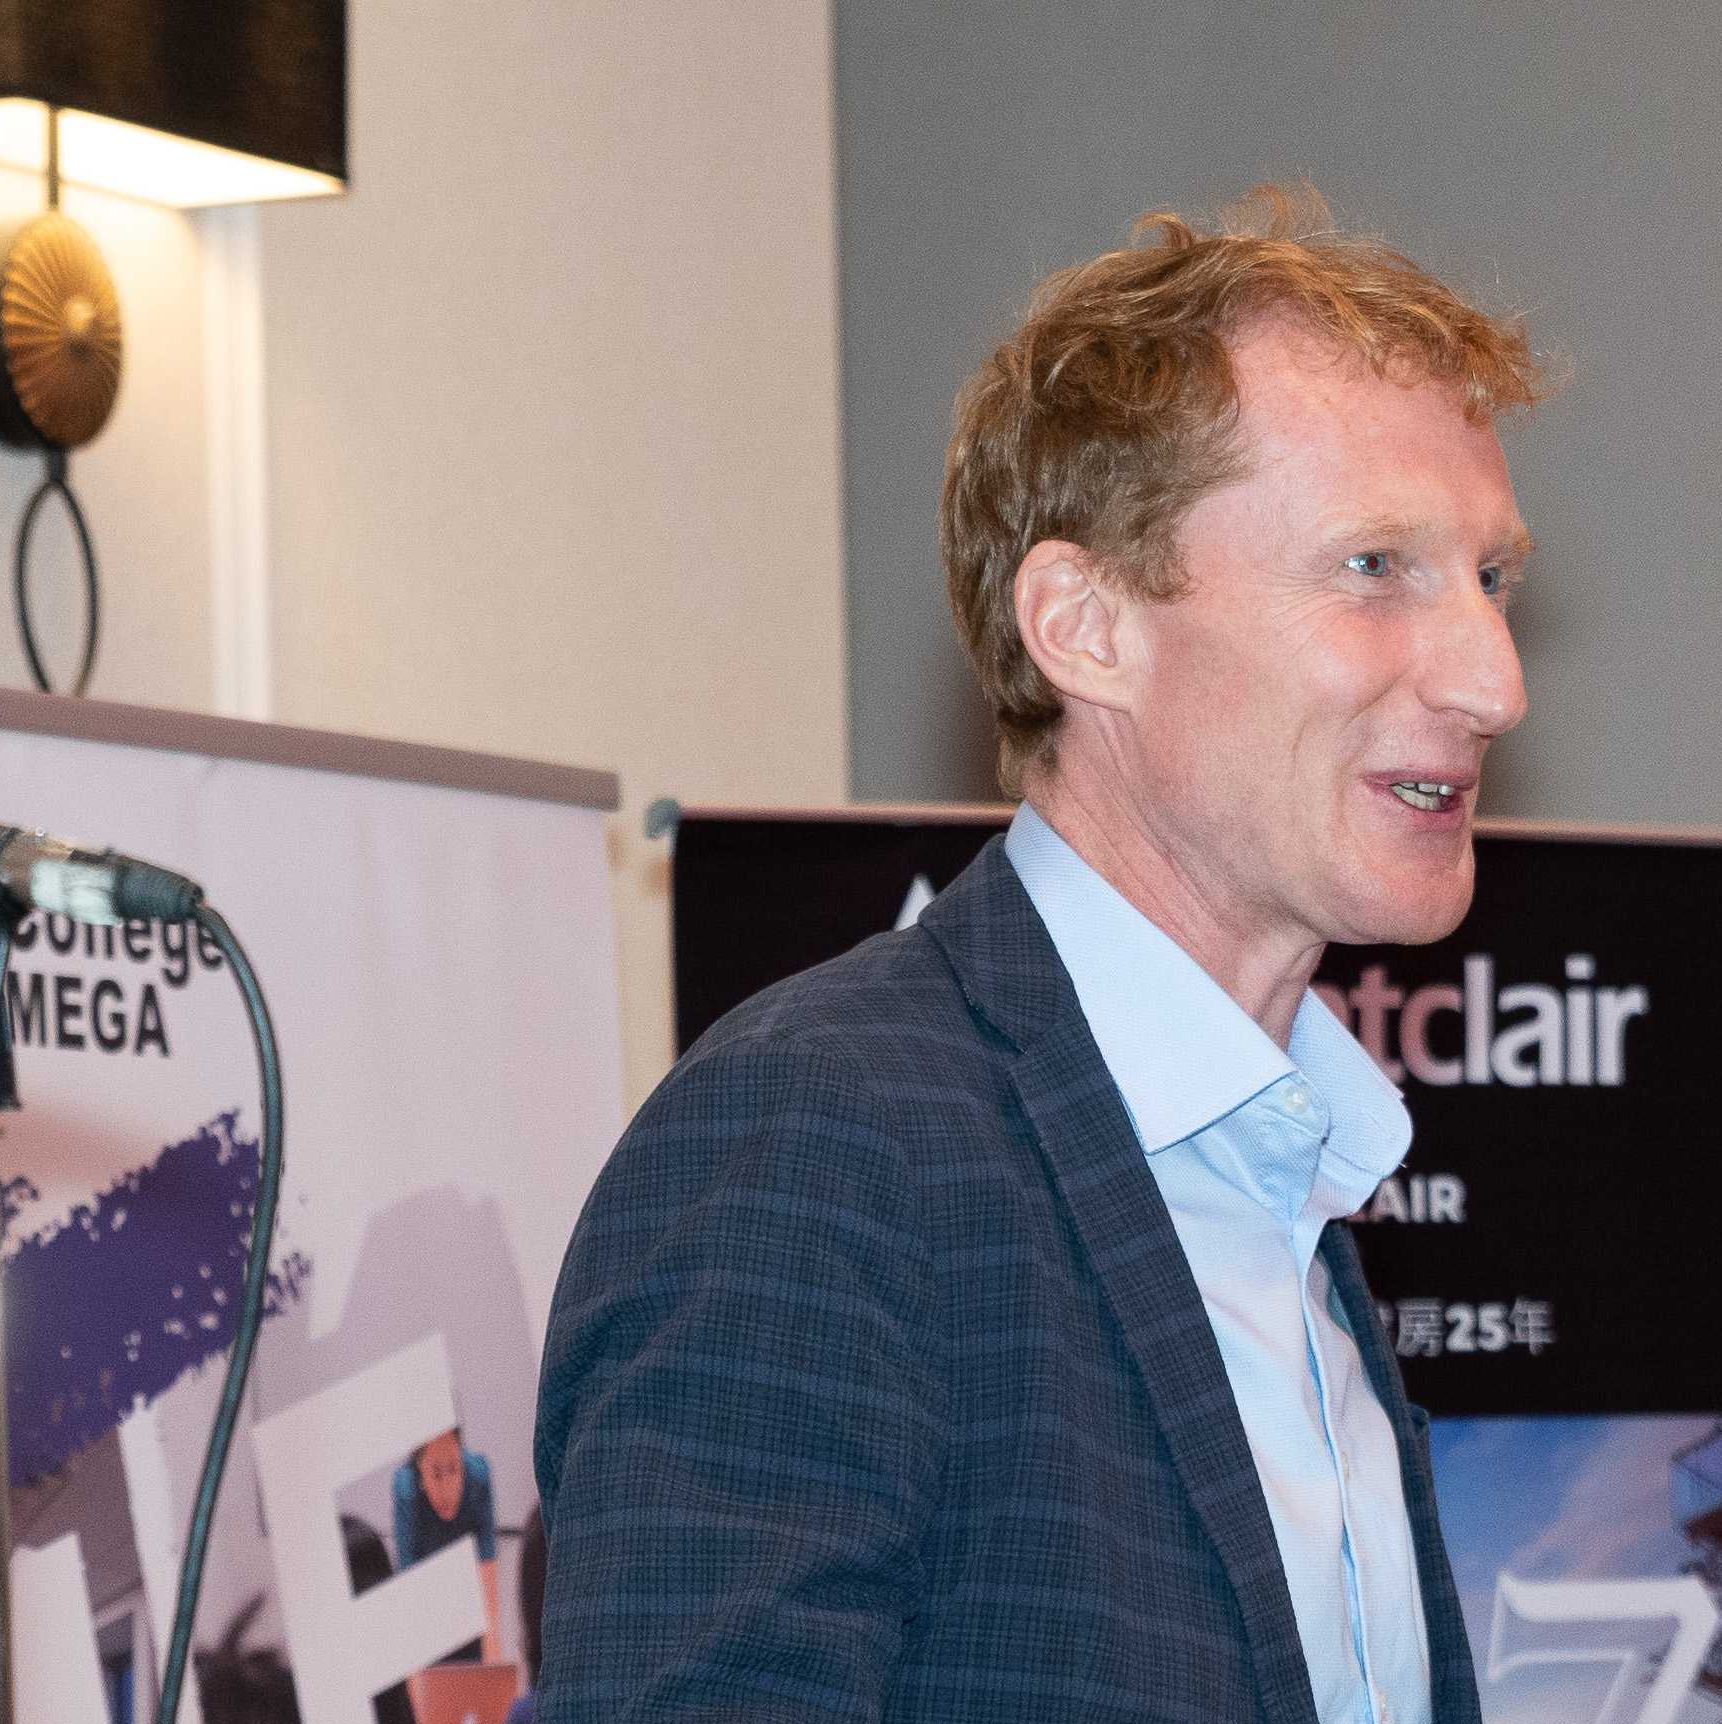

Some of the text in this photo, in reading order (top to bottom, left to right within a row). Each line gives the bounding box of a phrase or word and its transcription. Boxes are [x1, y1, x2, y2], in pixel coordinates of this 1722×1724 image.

[7, 970, 171, 1058] MEGA
[1313, 952, 1651, 1088] tclair
[1347, 1172, 1469, 1225] AIR
[1377, 1296, 1557, 1357] 房25年
